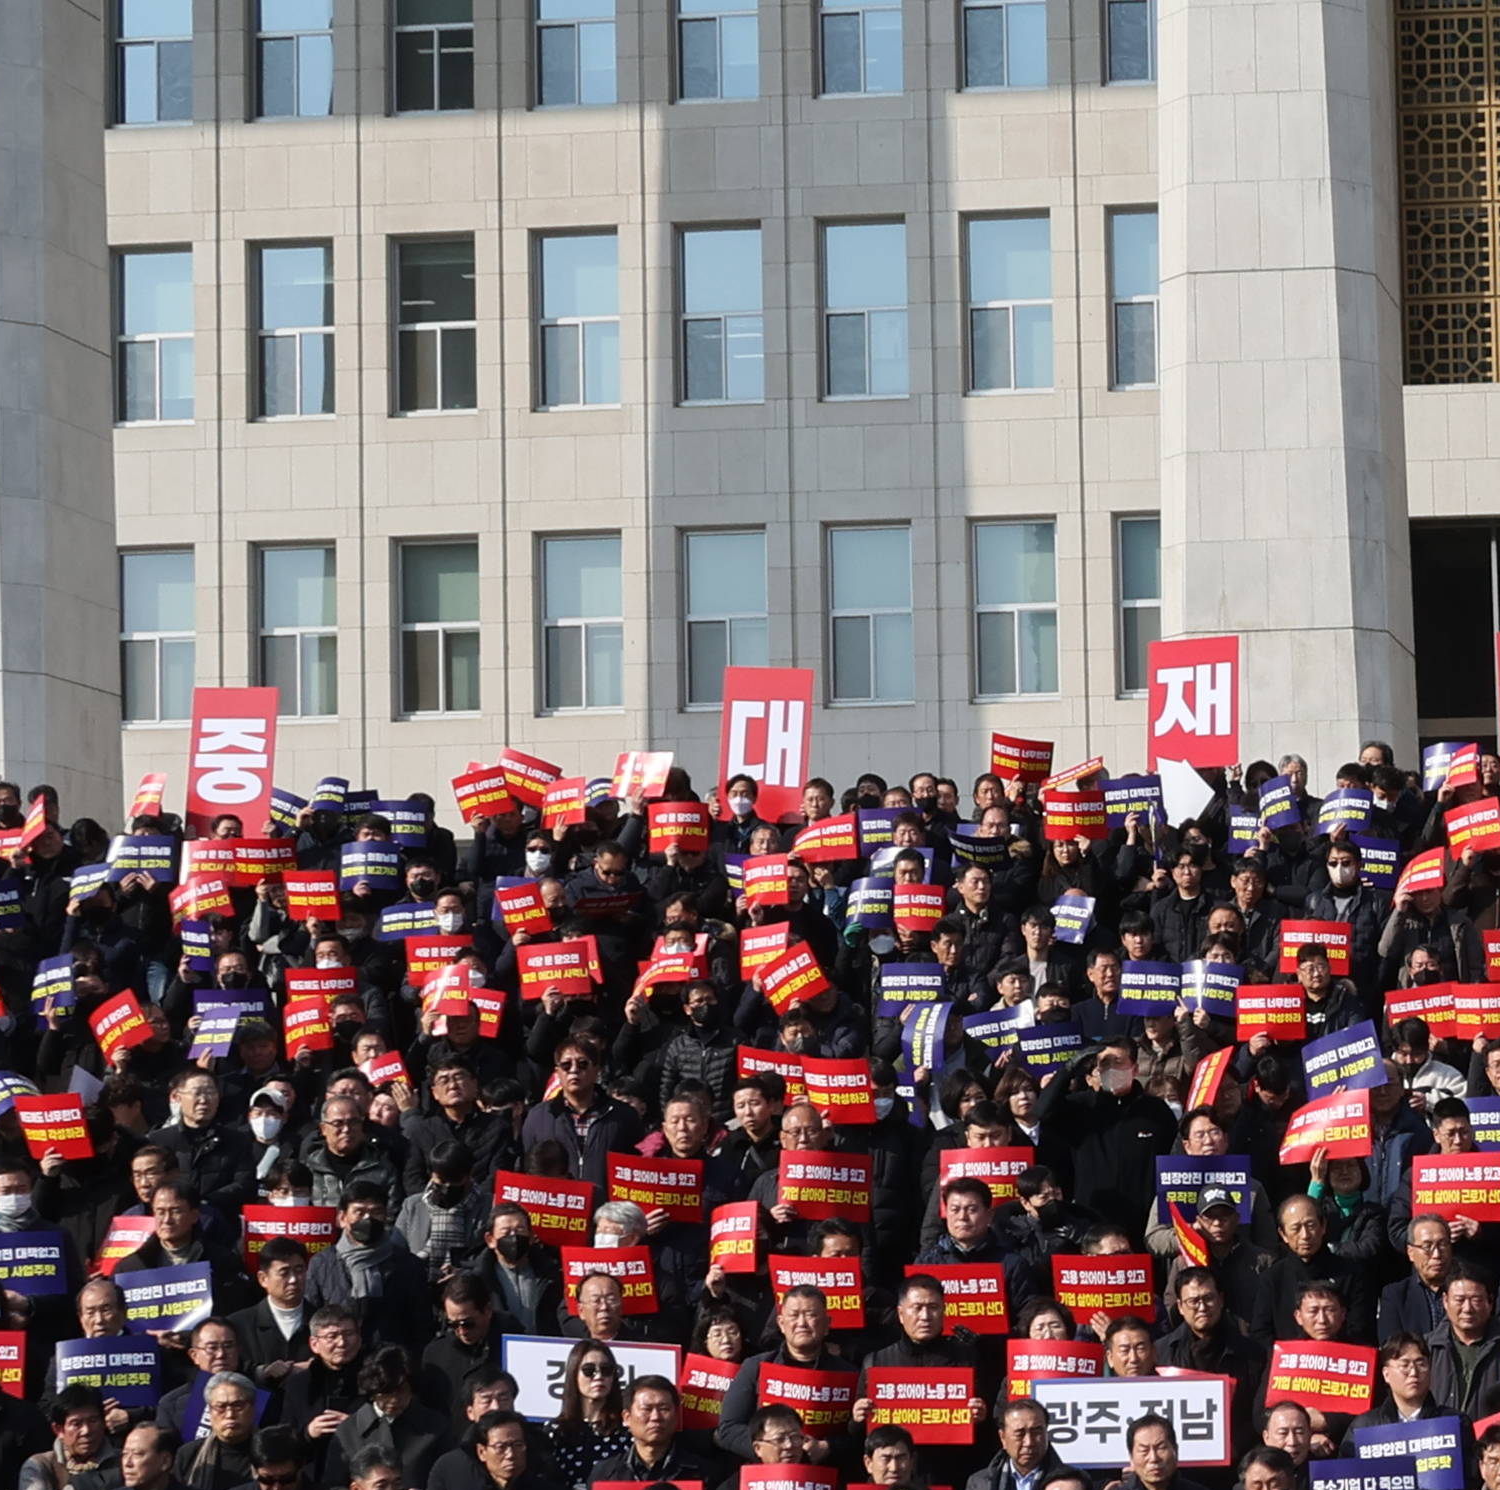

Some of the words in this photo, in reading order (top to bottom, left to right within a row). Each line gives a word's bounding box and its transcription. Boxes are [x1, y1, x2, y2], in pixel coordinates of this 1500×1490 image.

[1155, 662, 1231, 736] 재
[195, 719, 267, 804] 중
[727, 700, 804, 788] 대
